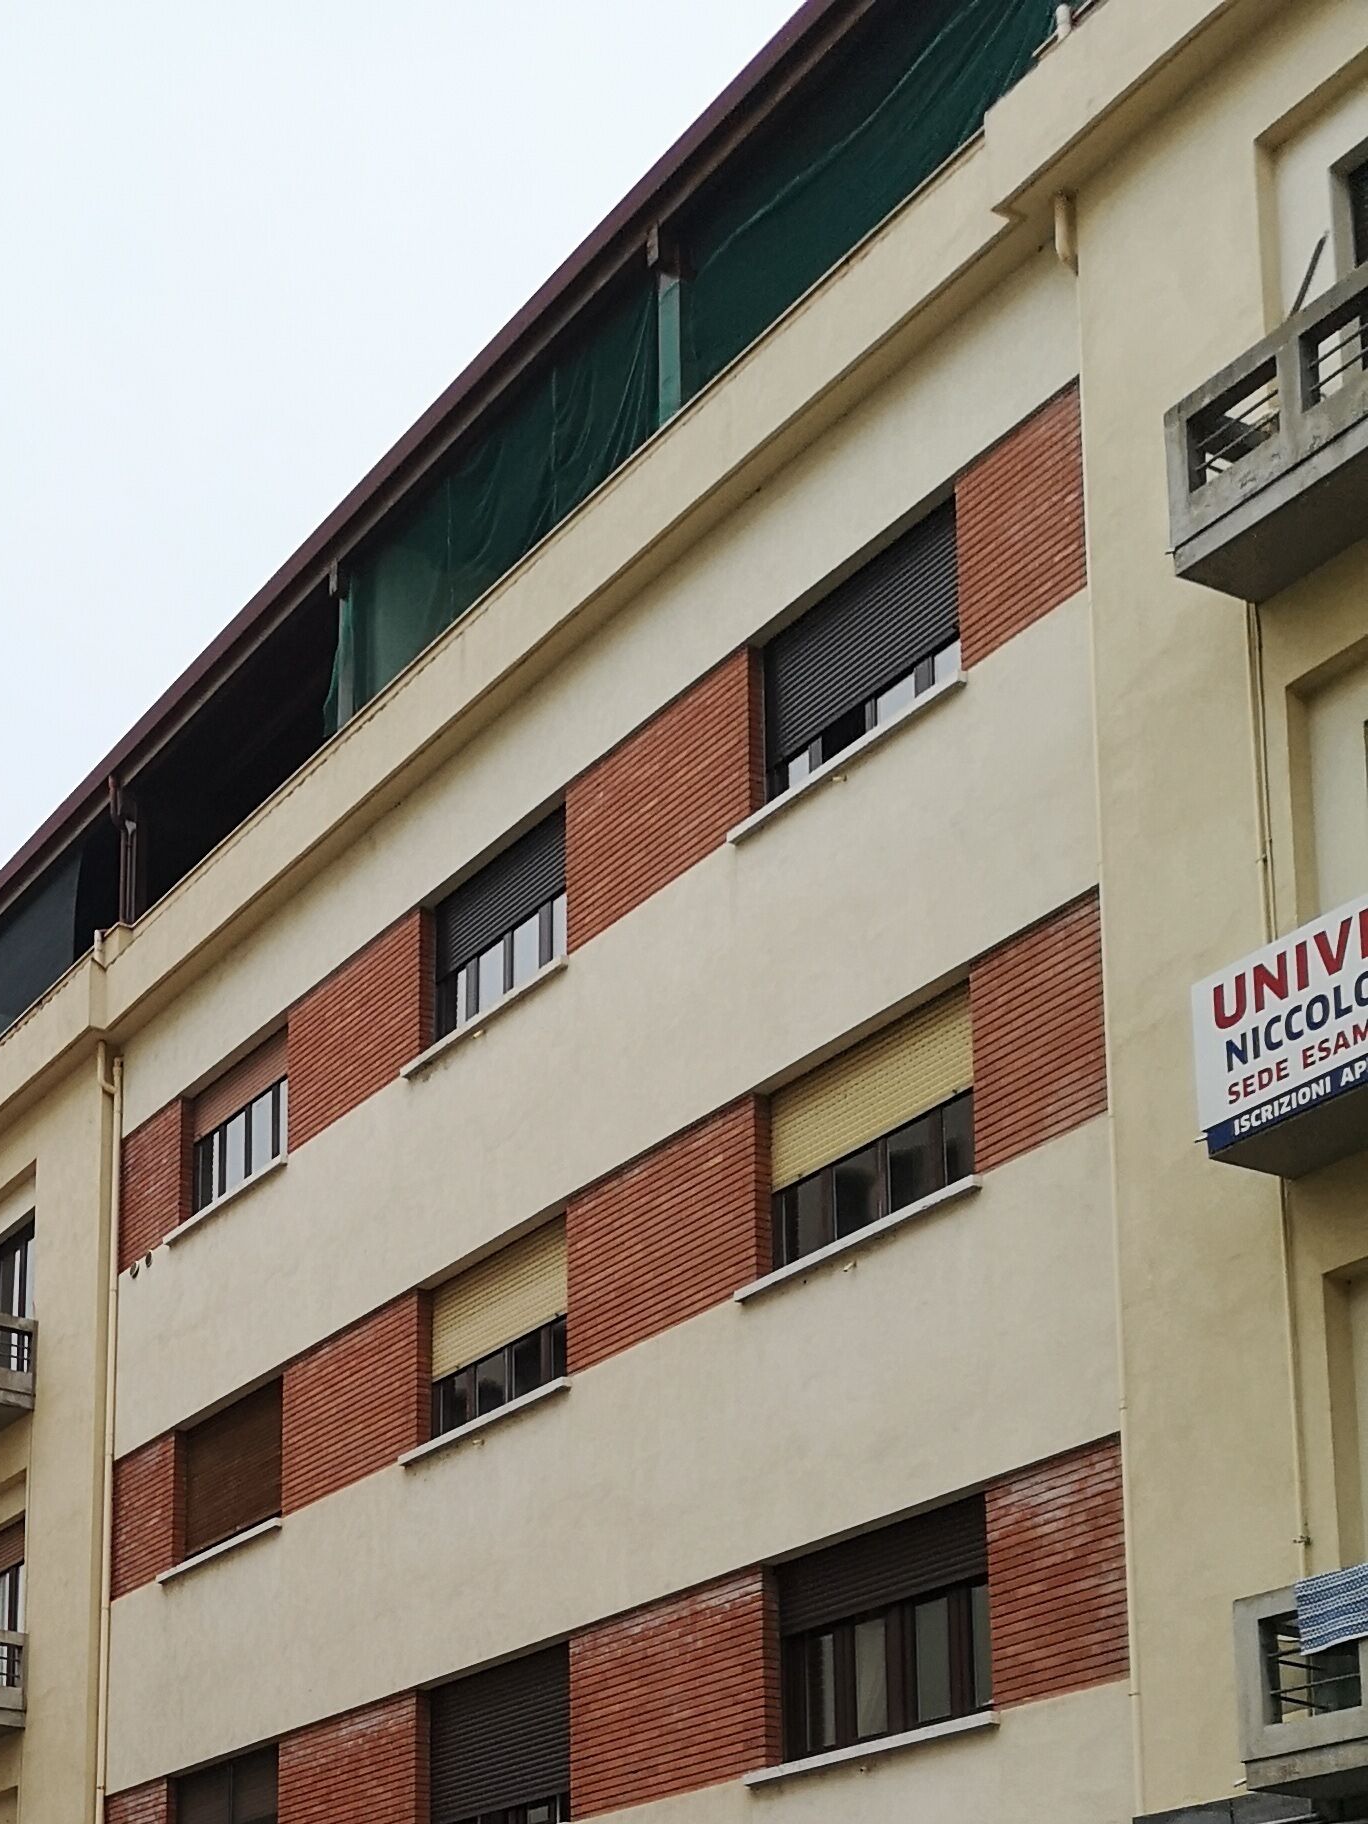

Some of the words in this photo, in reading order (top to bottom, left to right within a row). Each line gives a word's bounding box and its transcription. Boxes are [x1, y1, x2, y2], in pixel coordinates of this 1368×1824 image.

[1228, 1058, 1290, 1105] SEDE
[1233, 1076, 1331, 1136] ISCRIZIONI
[1340, 1057, 1368, 1087] AP
